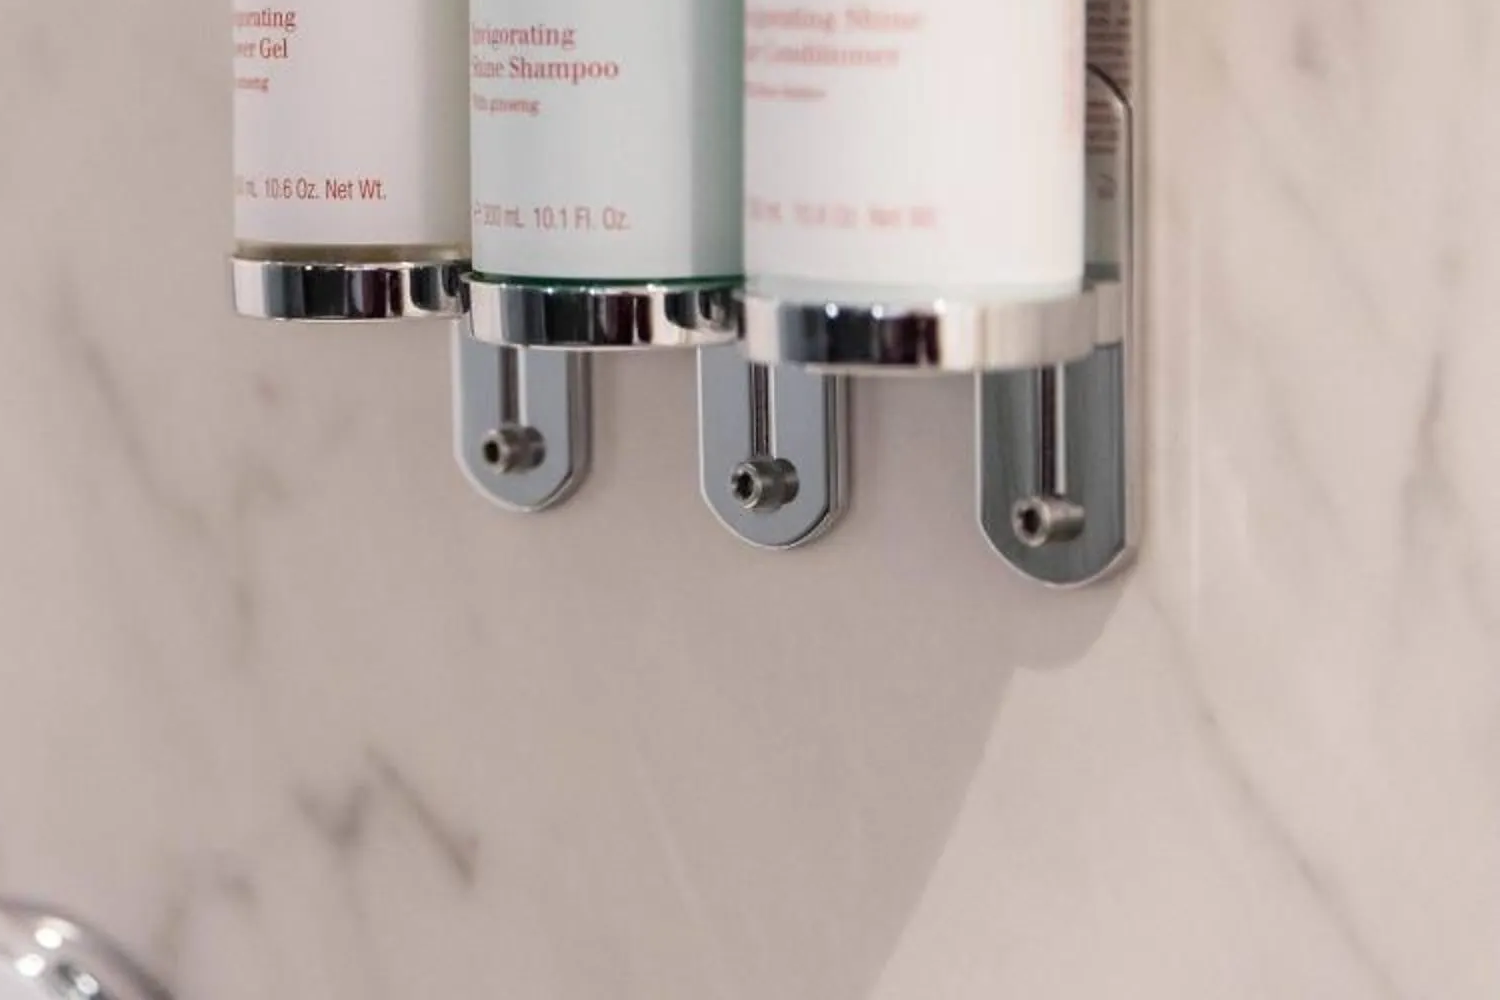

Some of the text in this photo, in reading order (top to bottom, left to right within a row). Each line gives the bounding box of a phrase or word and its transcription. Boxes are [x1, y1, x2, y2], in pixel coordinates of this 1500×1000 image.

[259, 37, 289, 59] Gel
[509, 56, 619, 85] Shampoo
[325, 178, 353, 200] Net
